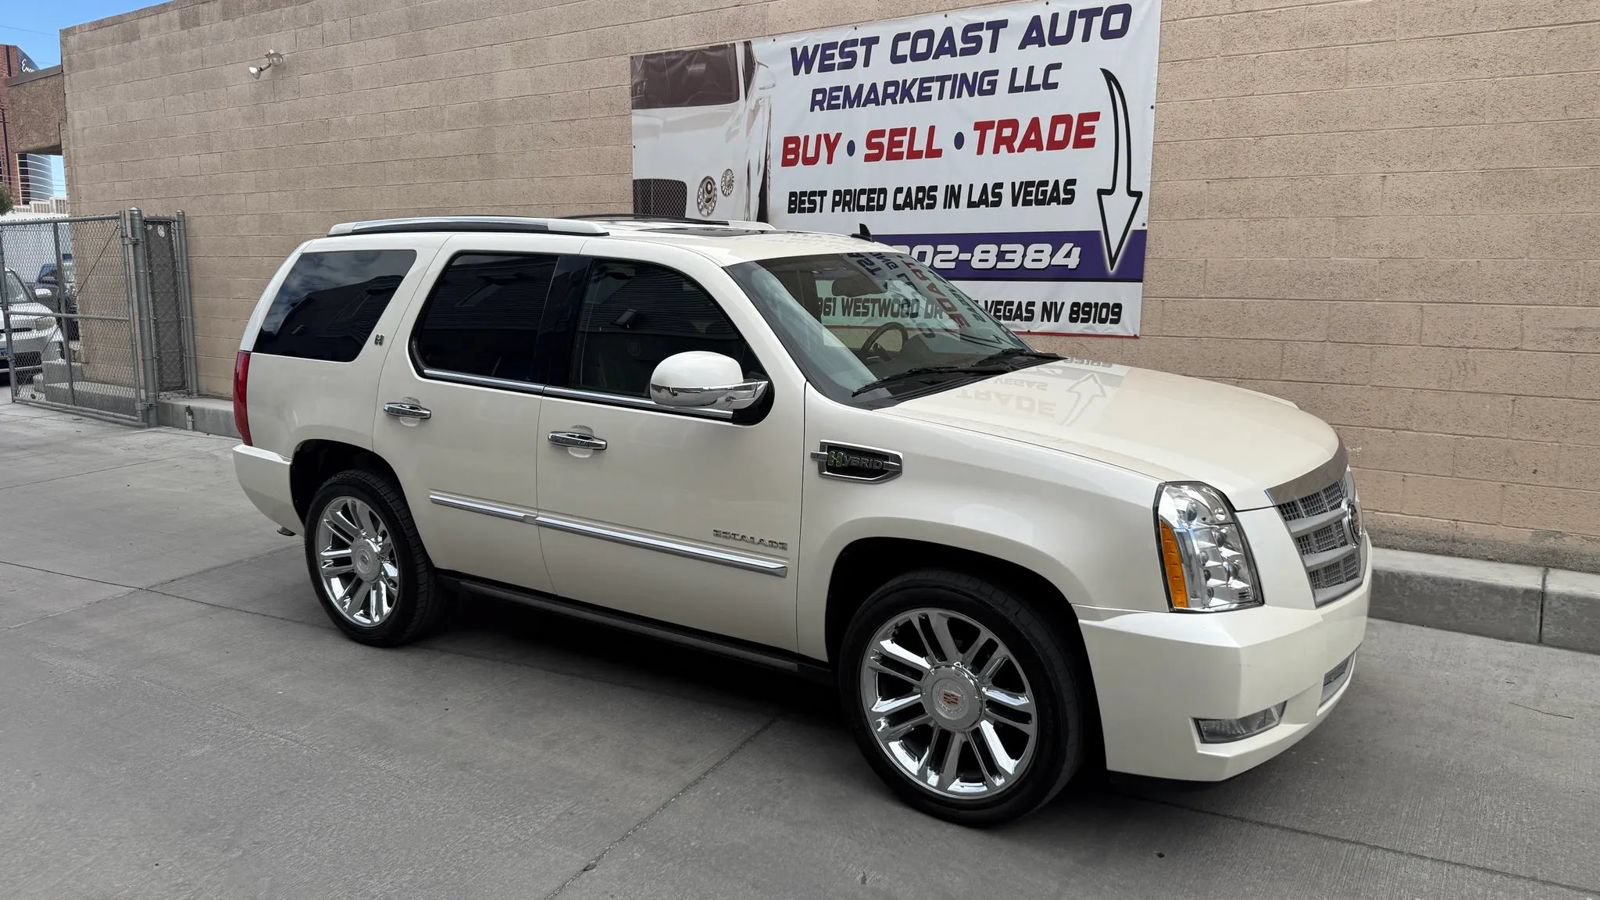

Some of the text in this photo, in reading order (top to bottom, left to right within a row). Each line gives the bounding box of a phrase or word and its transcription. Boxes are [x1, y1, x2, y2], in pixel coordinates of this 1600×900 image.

[790, 3, 1132, 76] WEST COAST AUTO
[809, 62, 1062, 112] REMARKETING LLC
[781, 111, 1101, 167] BUY SELL TRADE
[787, 178, 1077, 214] BEST PRICED CARS IN LAS VEGAS
[841, 297, 919, 318] WESTWOOD
[984, 300, 1122, 324] VEGAS NV 89109
[713, 529, 788, 551] ESCALADE
